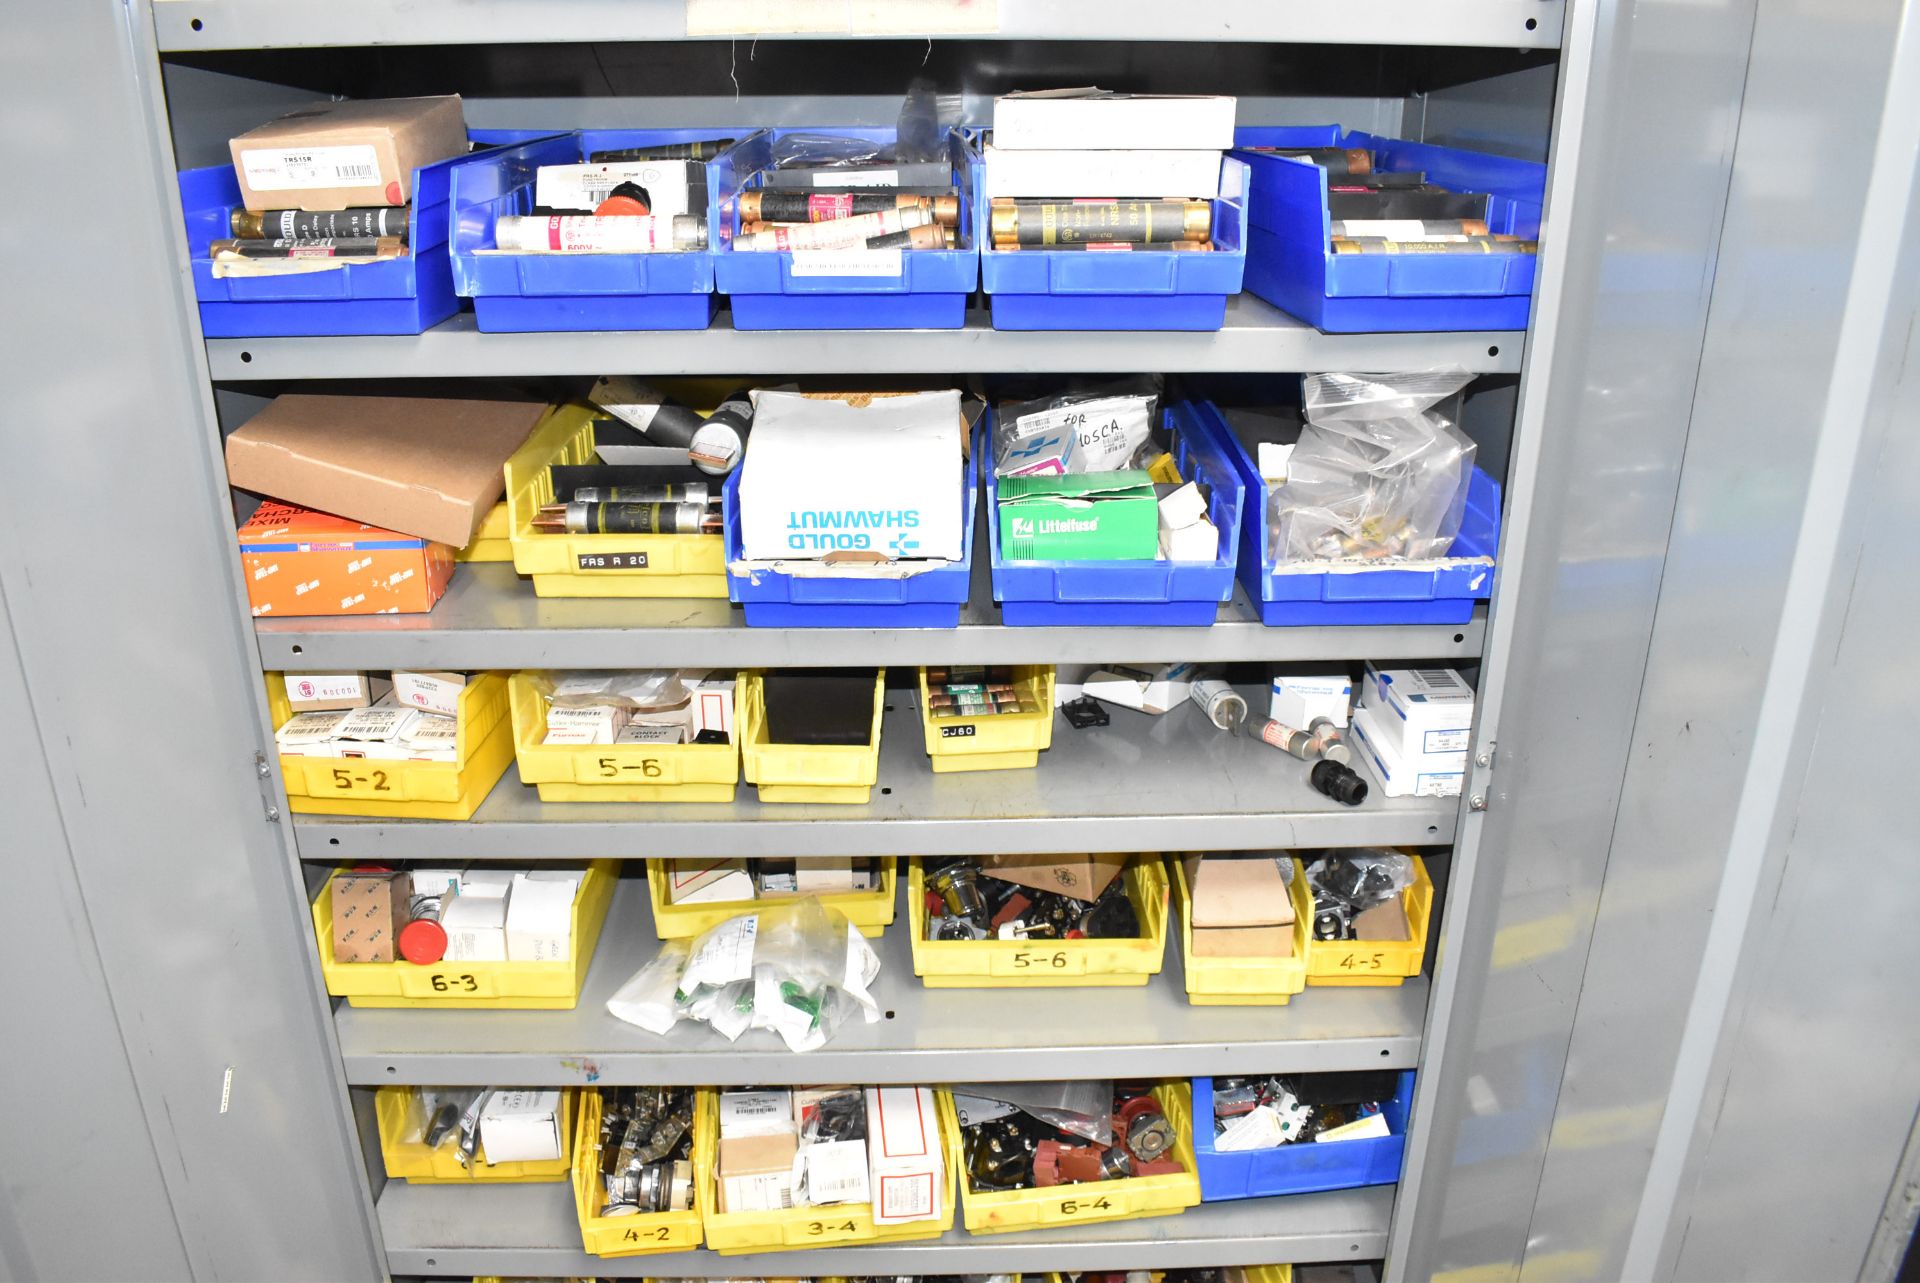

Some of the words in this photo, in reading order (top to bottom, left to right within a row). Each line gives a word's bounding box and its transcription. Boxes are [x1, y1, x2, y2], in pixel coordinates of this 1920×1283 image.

[787, 510, 920, 529] SHAWMUT
[1039, 517, 1098, 534] Littelfuse
[788, 533, 871, 550] GOULD
[580, 556, 605, 567] FRS
[613, 556, 621, 566] R
[630, 555, 646, 566] 20
[598, 758, 662, 778] 5-6
[332, 769, 390, 791] 5-2
[1014, 952, 1067, 968] 5-6
[1340, 954, 1384, 970] 4-5
[431, 974, 478, 992] 6-3
[1060, 1196, 1112, 1214] 6-4
[622, 1226, 670, 1242] 4-2
[808, 1220, 857, 1235] 3-4
